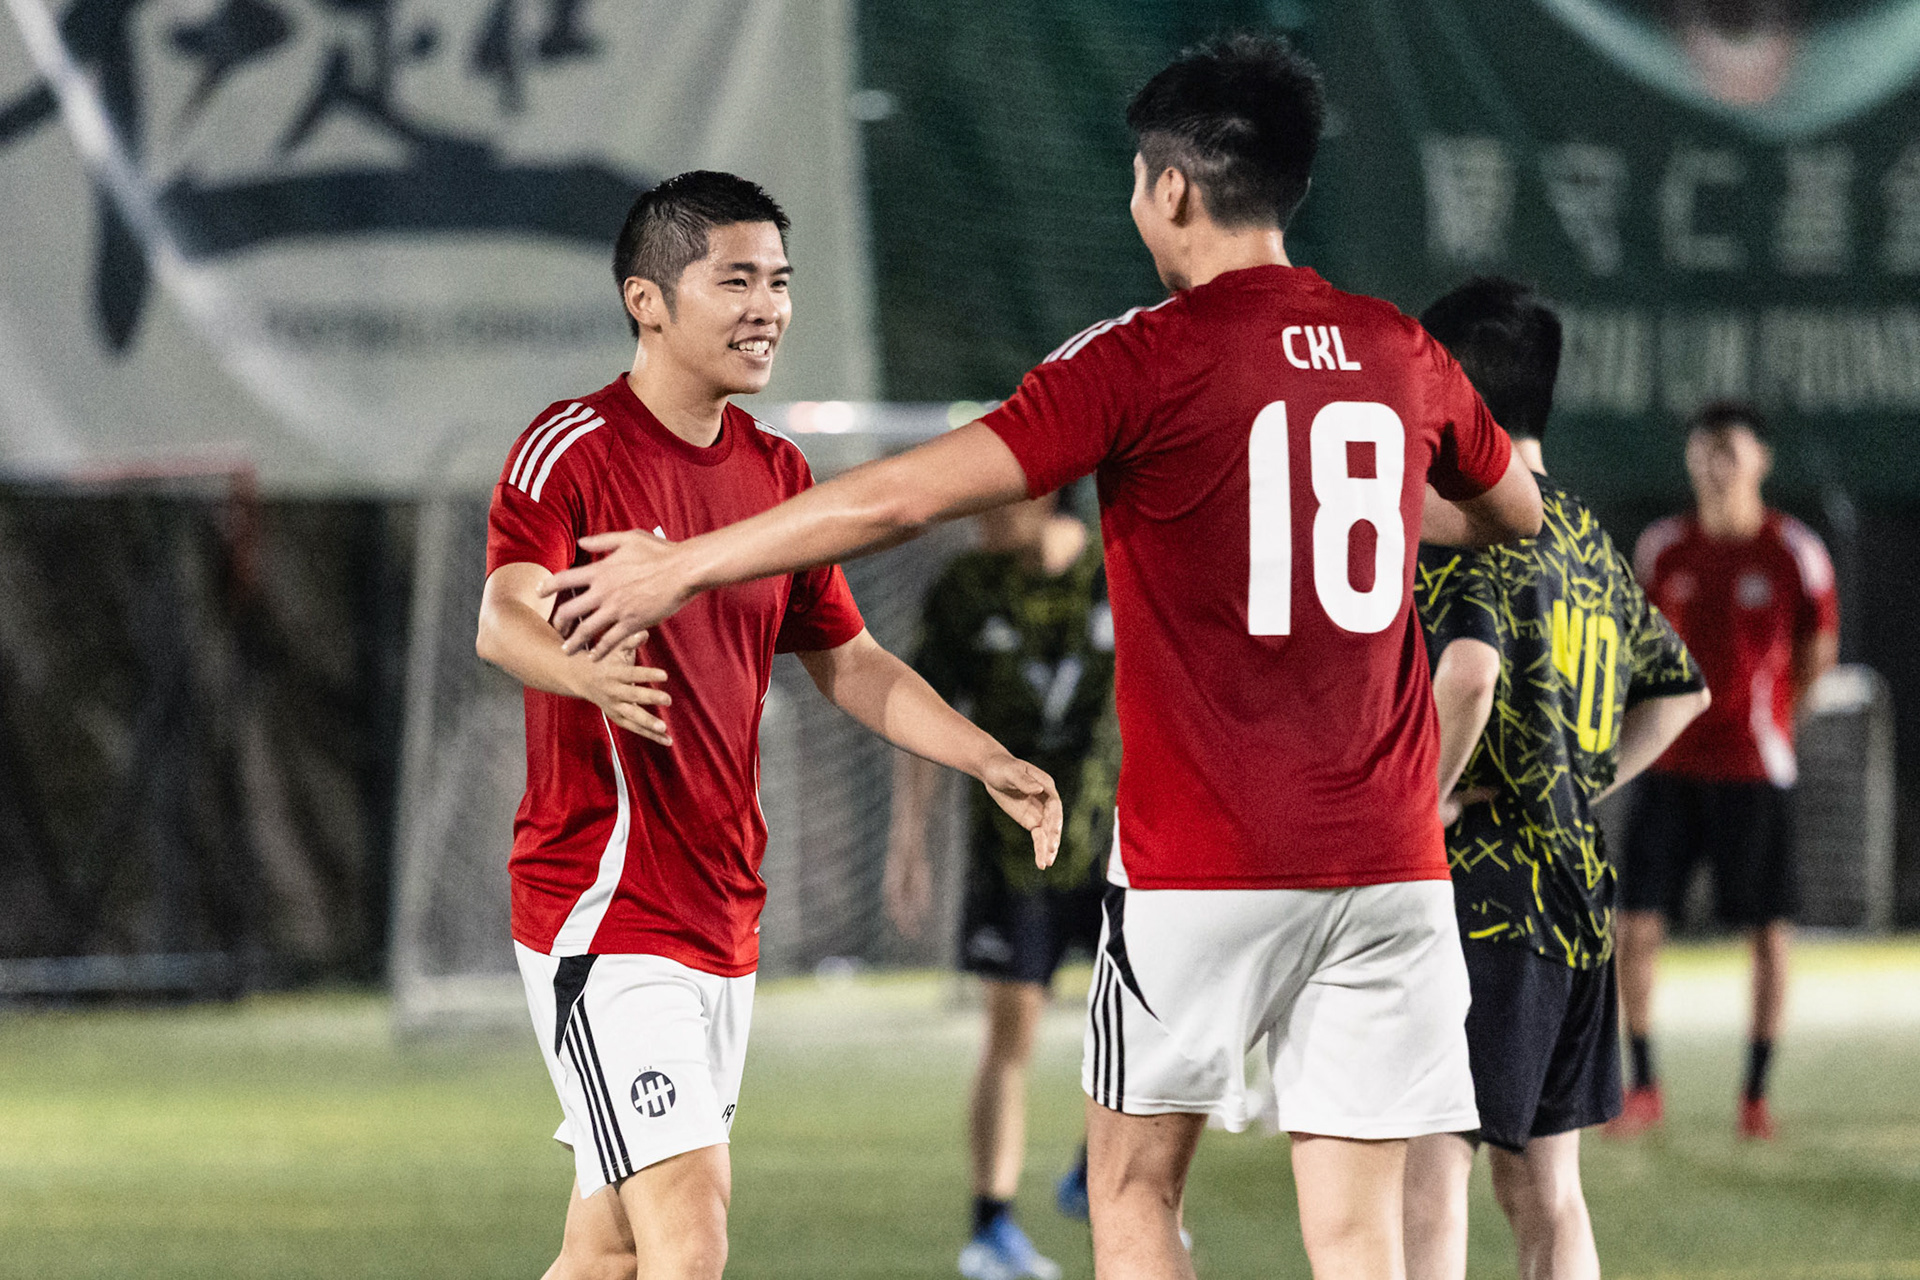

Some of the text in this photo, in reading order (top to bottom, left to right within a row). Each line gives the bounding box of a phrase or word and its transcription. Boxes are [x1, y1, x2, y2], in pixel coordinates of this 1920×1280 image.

[1282, 326, 1362, 371] CKL
[1248, 400, 1406, 636] 18
[721, 1104, 736, 1123] 19
